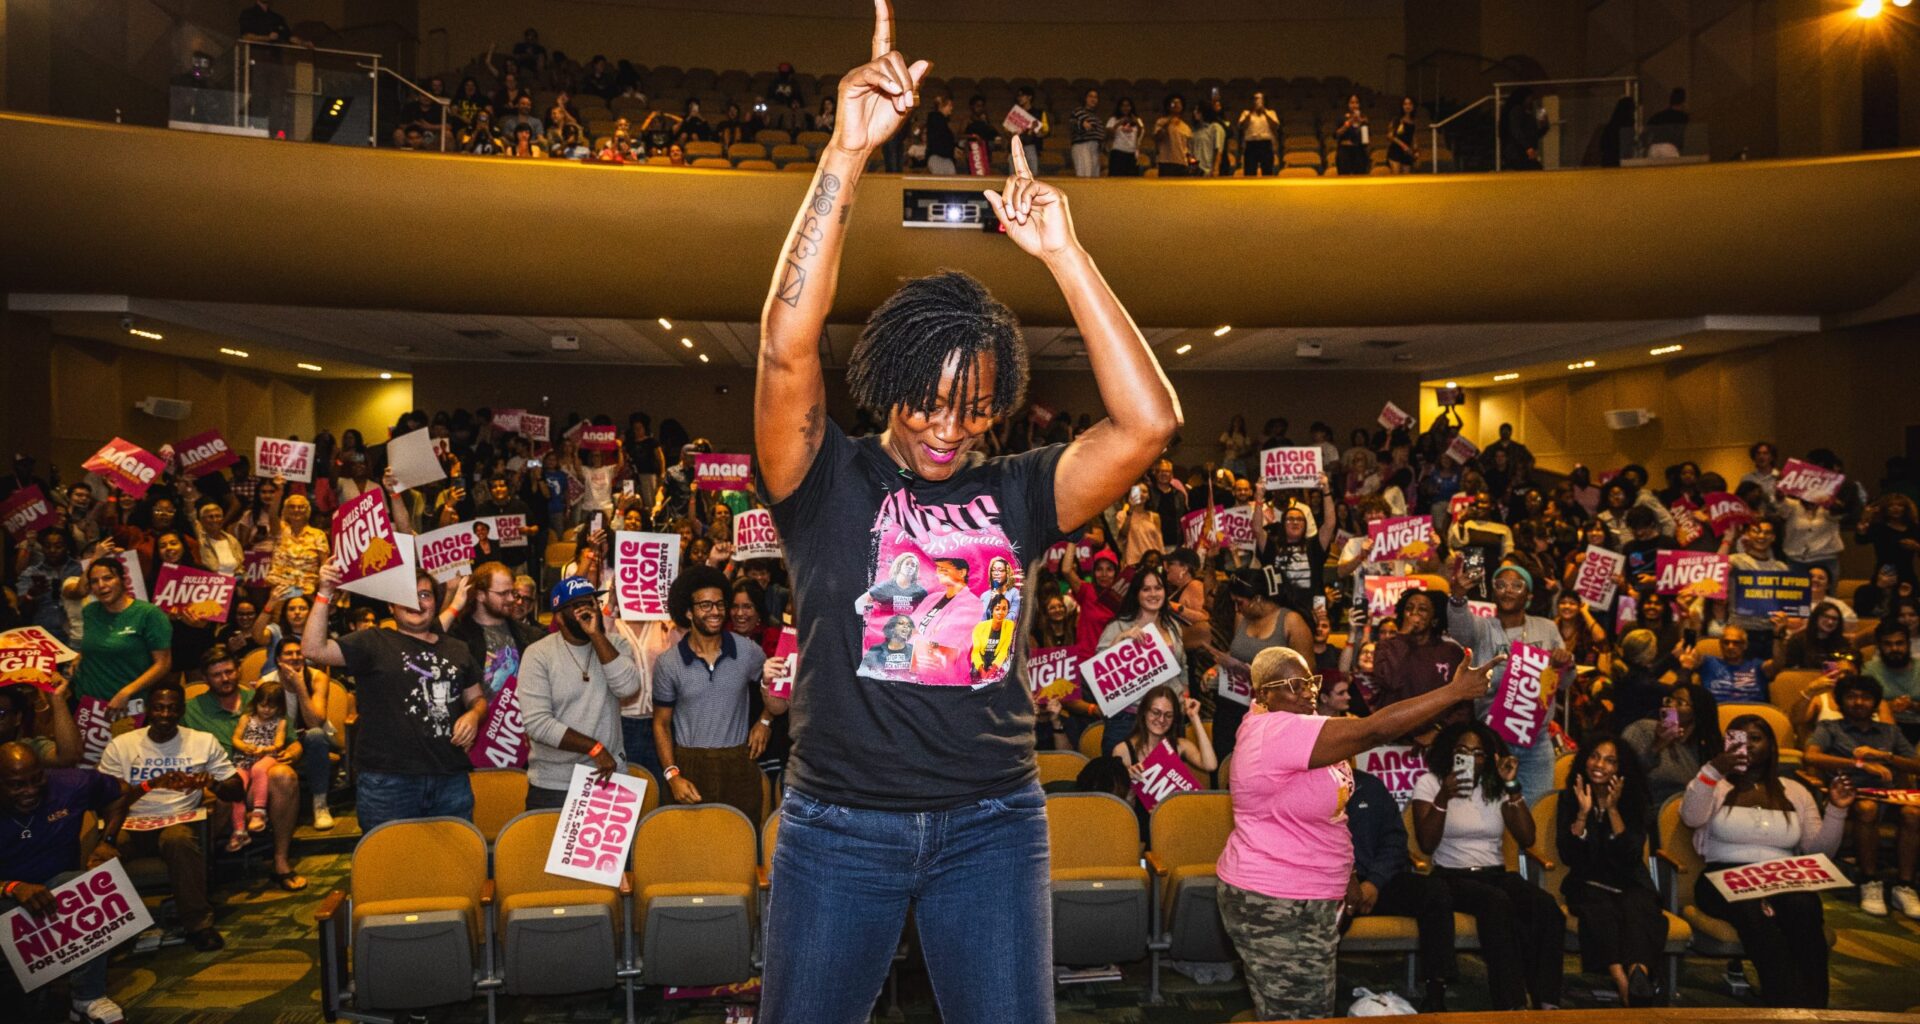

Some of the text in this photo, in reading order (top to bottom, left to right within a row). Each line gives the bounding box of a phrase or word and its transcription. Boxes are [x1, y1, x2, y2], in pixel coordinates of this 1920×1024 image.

[103, 447, 156, 484] ANGIE
[180, 439, 228, 467] ANGIE
[1266, 450, 1315, 464] ANGIE
[698, 463, 748, 478] ANGIE
[1265, 462, 1316, 476] NIXON
[359, 495, 373, 516] FOR
[738, 513, 770, 530] ANG
[332, 502, 388, 574] ANGIE
[422, 533, 472, 558] ANGIE
[738, 528, 777, 545] NIXO
[1370, 522, 1431, 562] ANGIE
[422, 546, 476, 571] NIXON
[208, 576, 226, 584] FOR
[620, 541, 643, 613] ANGIE
[640, 542, 663, 614] NIXON
[1656, 562, 1728, 591] ANGIE
[154, 580, 234, 606] ANGIE
[0, 656, 54, 674] GIE
[1027, 649, 1067, 668] ULLS FOR
[1093, 633, 1156, 680] ANGIE
[1511, 654, 1522, 678] FOR
[1028, 656, 1078, 691] NGIE
[1097, 648, 1165, 696] NIXON
[1104, 690, 1121, 703] FOR
[1121, 683, 1137, 693] U.S.
[1504, 645, 1550, 745] ANGIE
[486, 687, 513, 740] BULLS FOR
[485, 689, 525, 768] ANG
[145, 757, 192, 766] ROBERT
[581, 776, 594, 798] FOR
[1166, 768, 1193, 791] BULLS
[574, 799, 588, 820] U.S.
[571, 780, 617, 868] NIXON
[595, 783, 638, 874] ANGIE
[1723, 858, 1821, 881] ANGIE
[1725, 869, 1831, 890] NIXON
[15, 892, 130, 965] NIXON
[27, 955, 55, 974] FOR
[55, 943, 83, 959] U.S.
